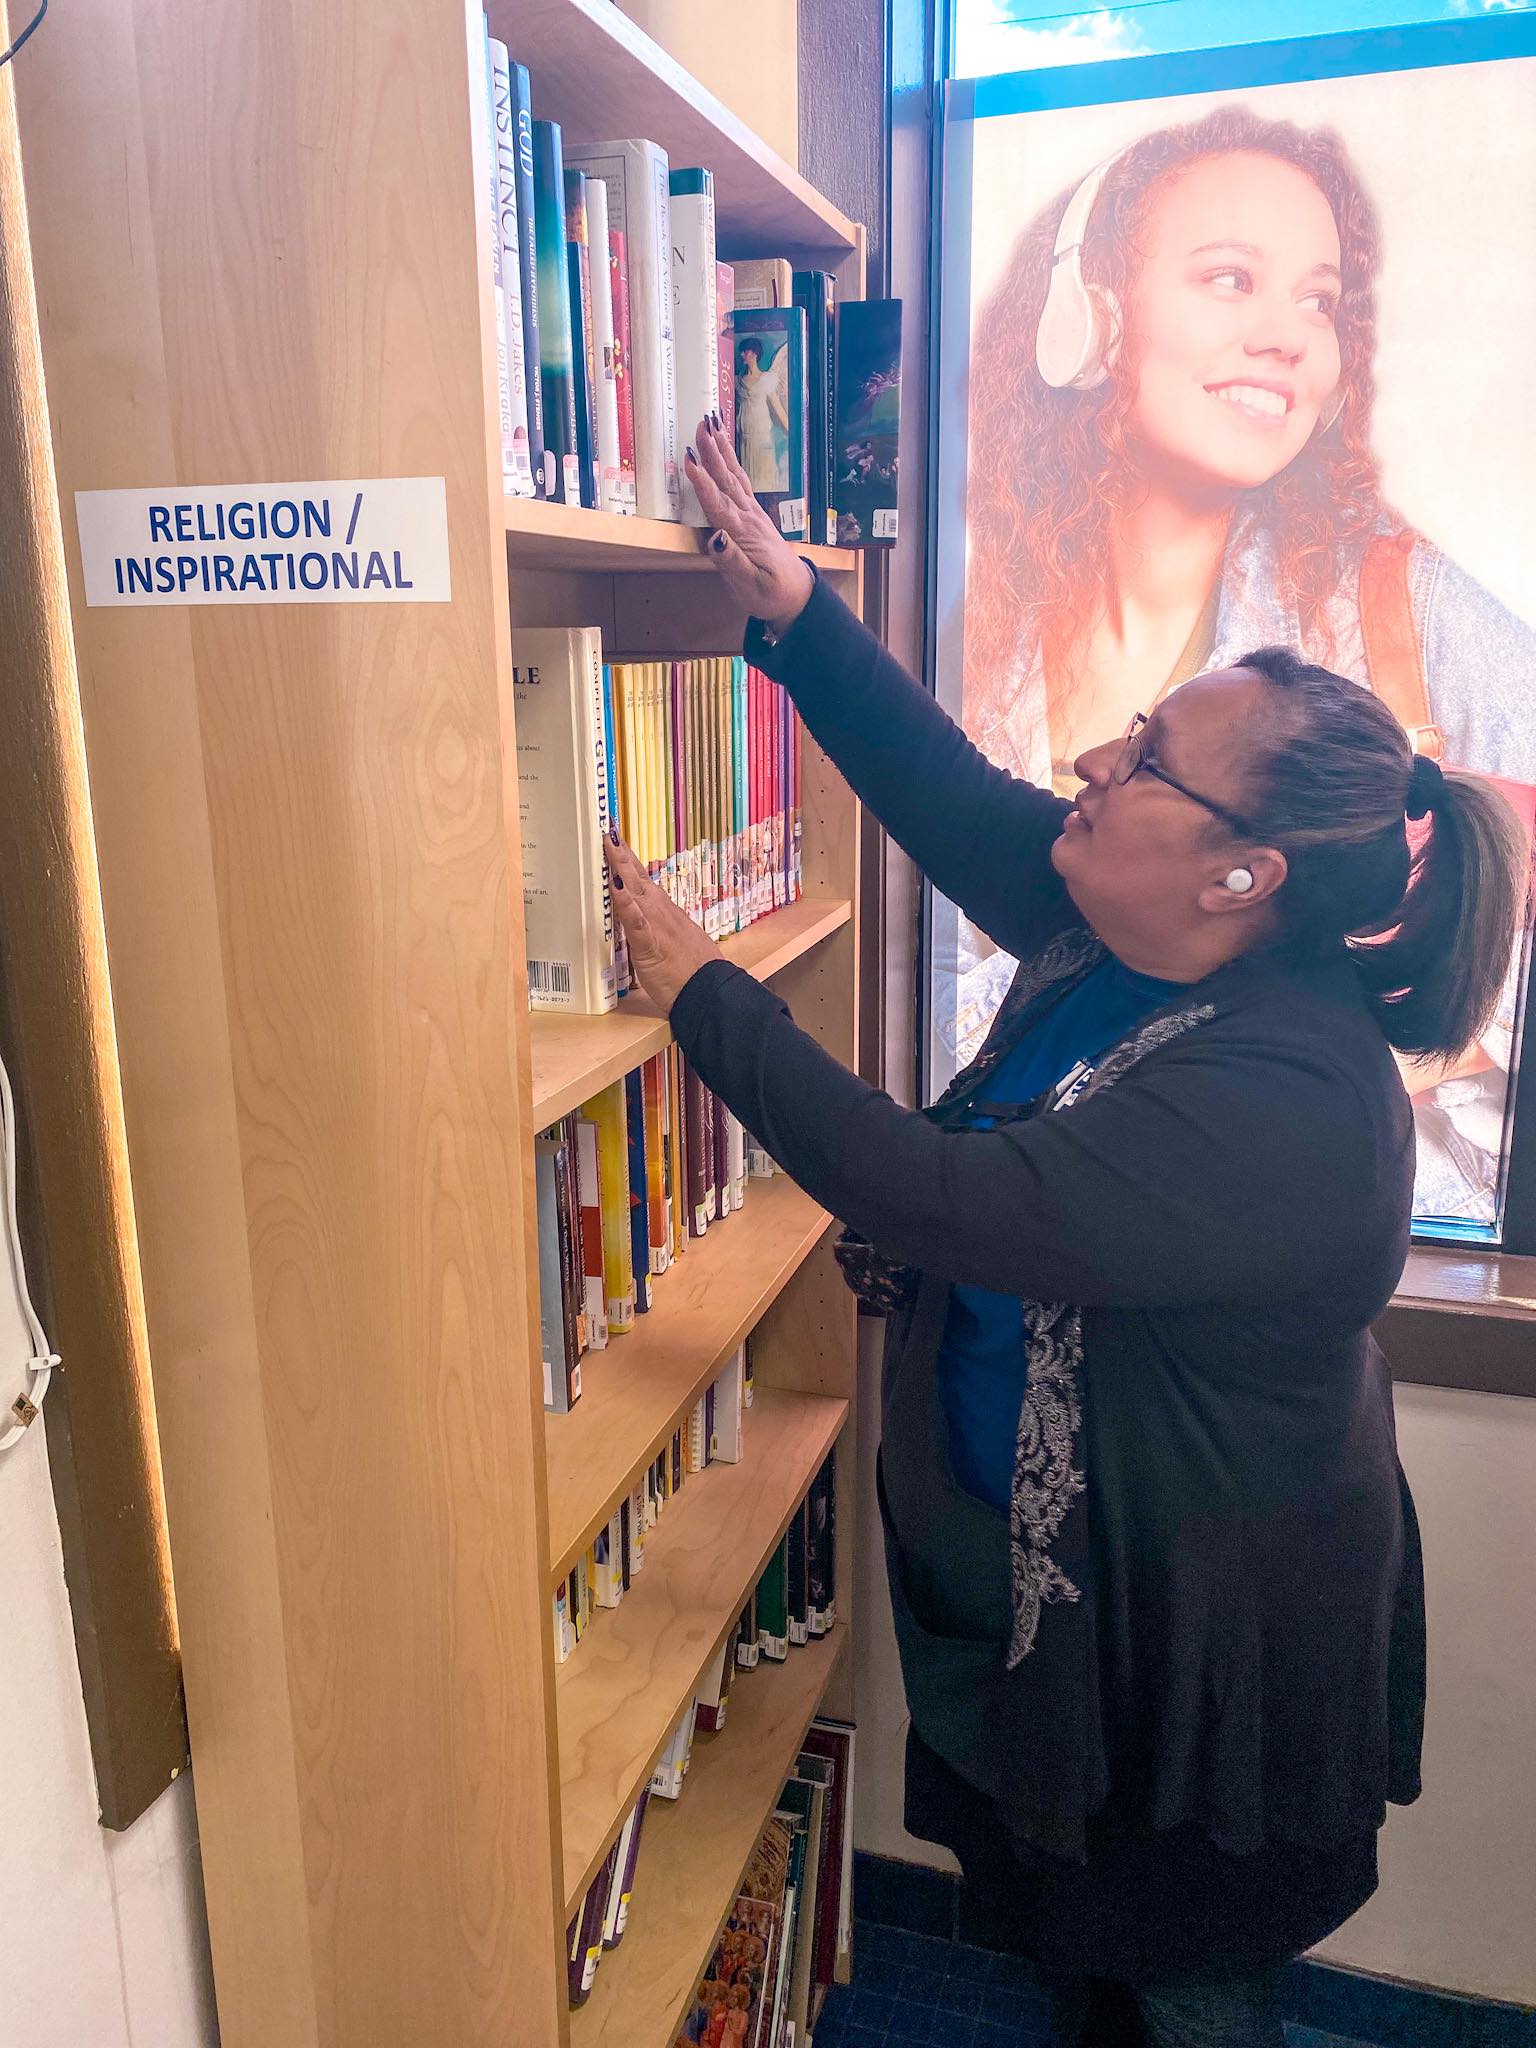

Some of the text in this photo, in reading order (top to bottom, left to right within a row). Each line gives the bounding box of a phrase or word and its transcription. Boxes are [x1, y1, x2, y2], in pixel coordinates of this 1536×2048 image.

[493, 64, 519, 264] INSTINCT
[518, 109, 534, 177] GOD
[530, 269, 538, 327] HYPOTHESIS
[510, 293, 524, 396] T.D. Jakes
[721, 358, 732, 396] 365
[497, 337, 511, 432] Jon Kraka
[569, 387, 578, 455] DOBSO
[148, 493, 363, 545] RELIGION /
[114, 550, 413, 594] INSPIRATIONAL
[592, 650, 602, 730] COMPLETE
[595, 739, 608, 829] GUIDE
